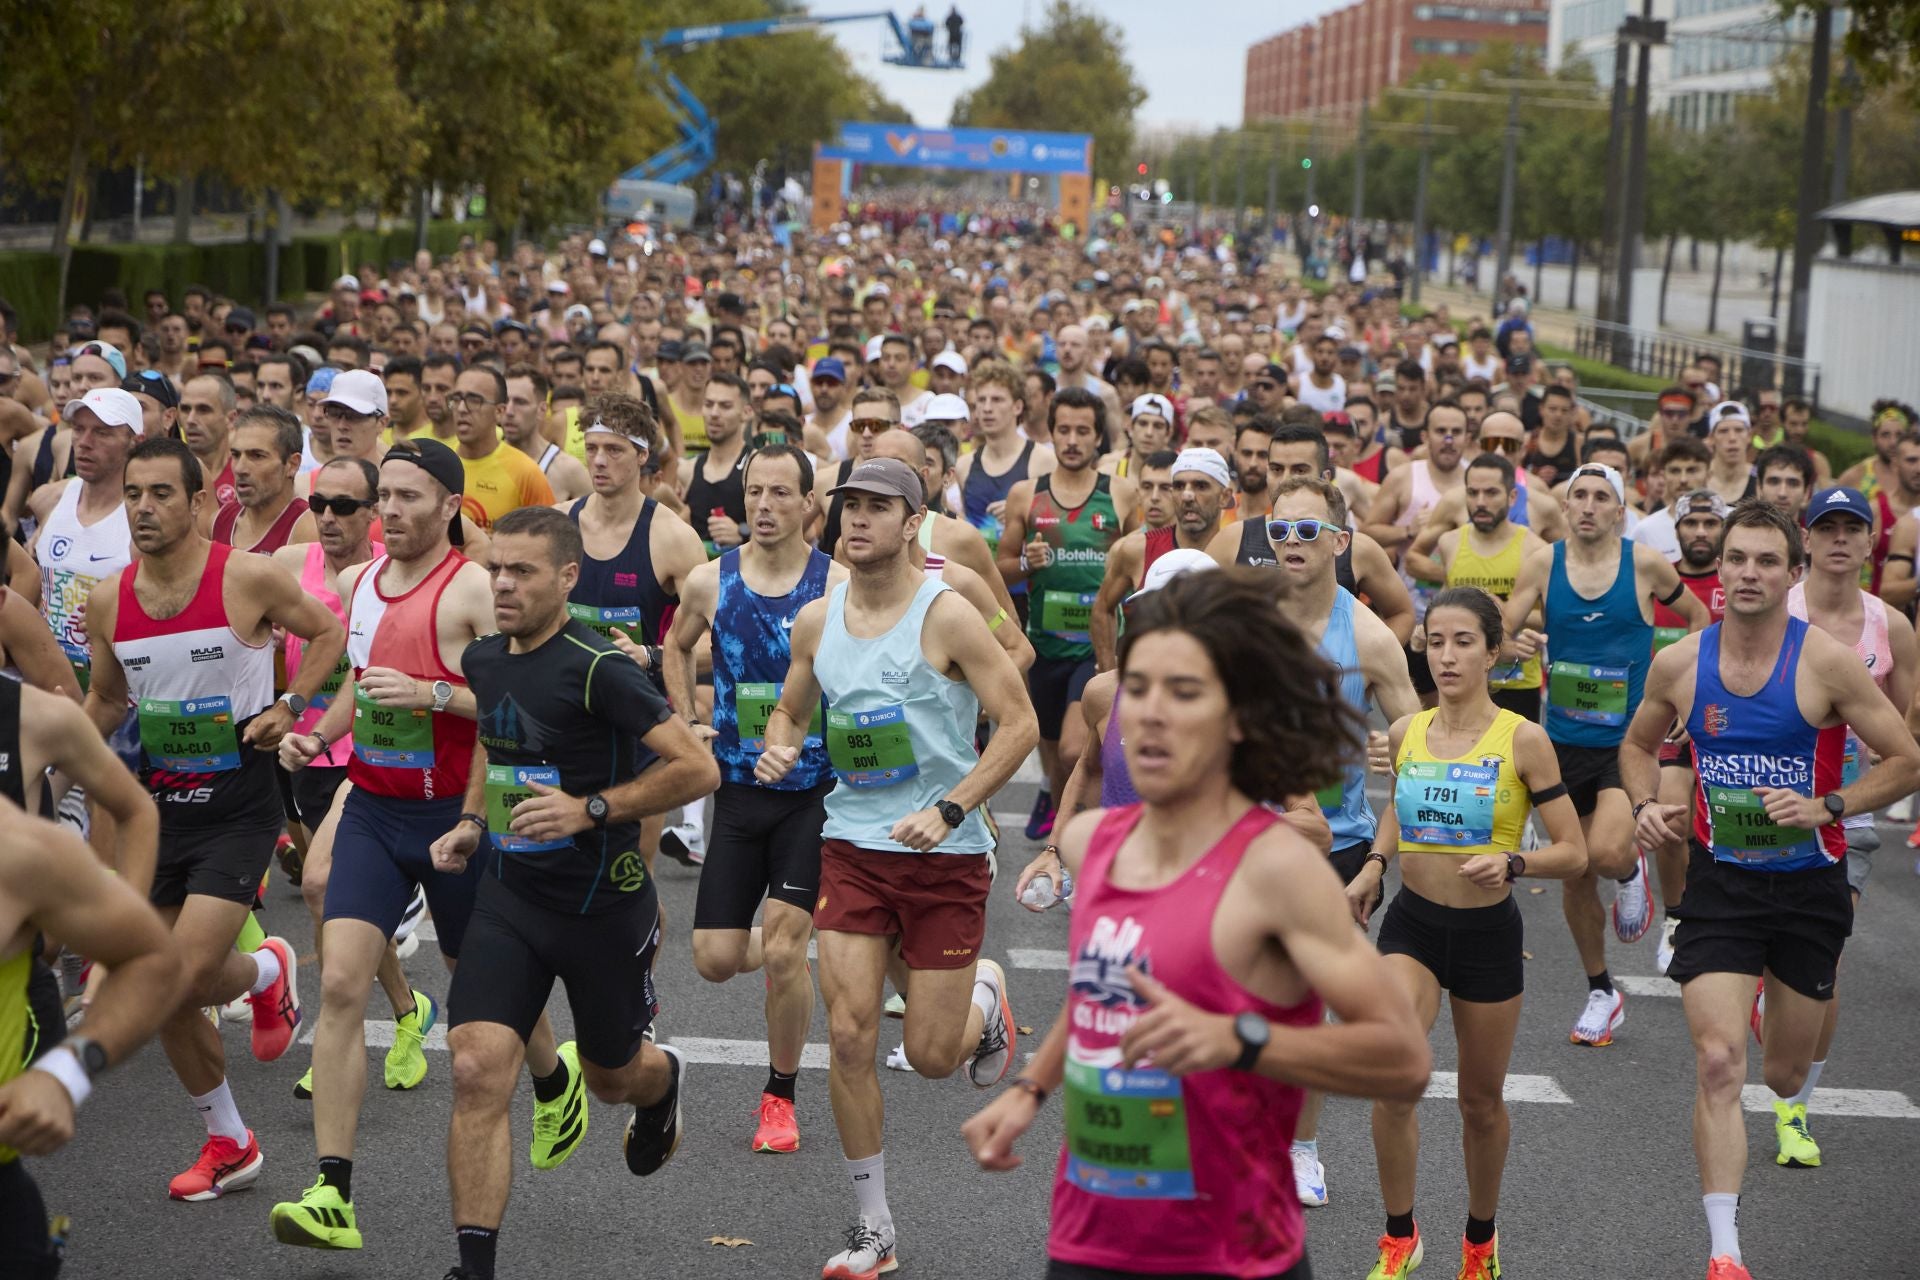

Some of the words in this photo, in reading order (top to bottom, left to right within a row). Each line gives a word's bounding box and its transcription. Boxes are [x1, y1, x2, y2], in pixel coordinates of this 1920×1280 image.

[190, 646, 223, 656] MUUR
[1576, 681, 1600, 695] 992
[198, 700, 224, 710] ZURICH
[371, 710, 396, 727] 902
[870, 711, 897, 722] ZURICH
[168, 721, 197, 736] 753
[373, 733, 396, 747] Alex
[847, 734, 873, 749] 983
[163, 741, 212, 755] CLA-CLO
[1702, 754, 1807, 774] HASTINGS
[528, 771, 554, 780] ZURICH
[1463, 769, 1492, 781] ZURICH
[1702, 769, 1764, 787] ATHLETIC
[1768, 771, 1810, 787] CLUB
[1423, 786, 1460, 804] 1791
[1417, 809, 1465, 826] REBECA
[1745, 834, 1778, 847] MIKE
[943, 948, 972, 956] MUUR
